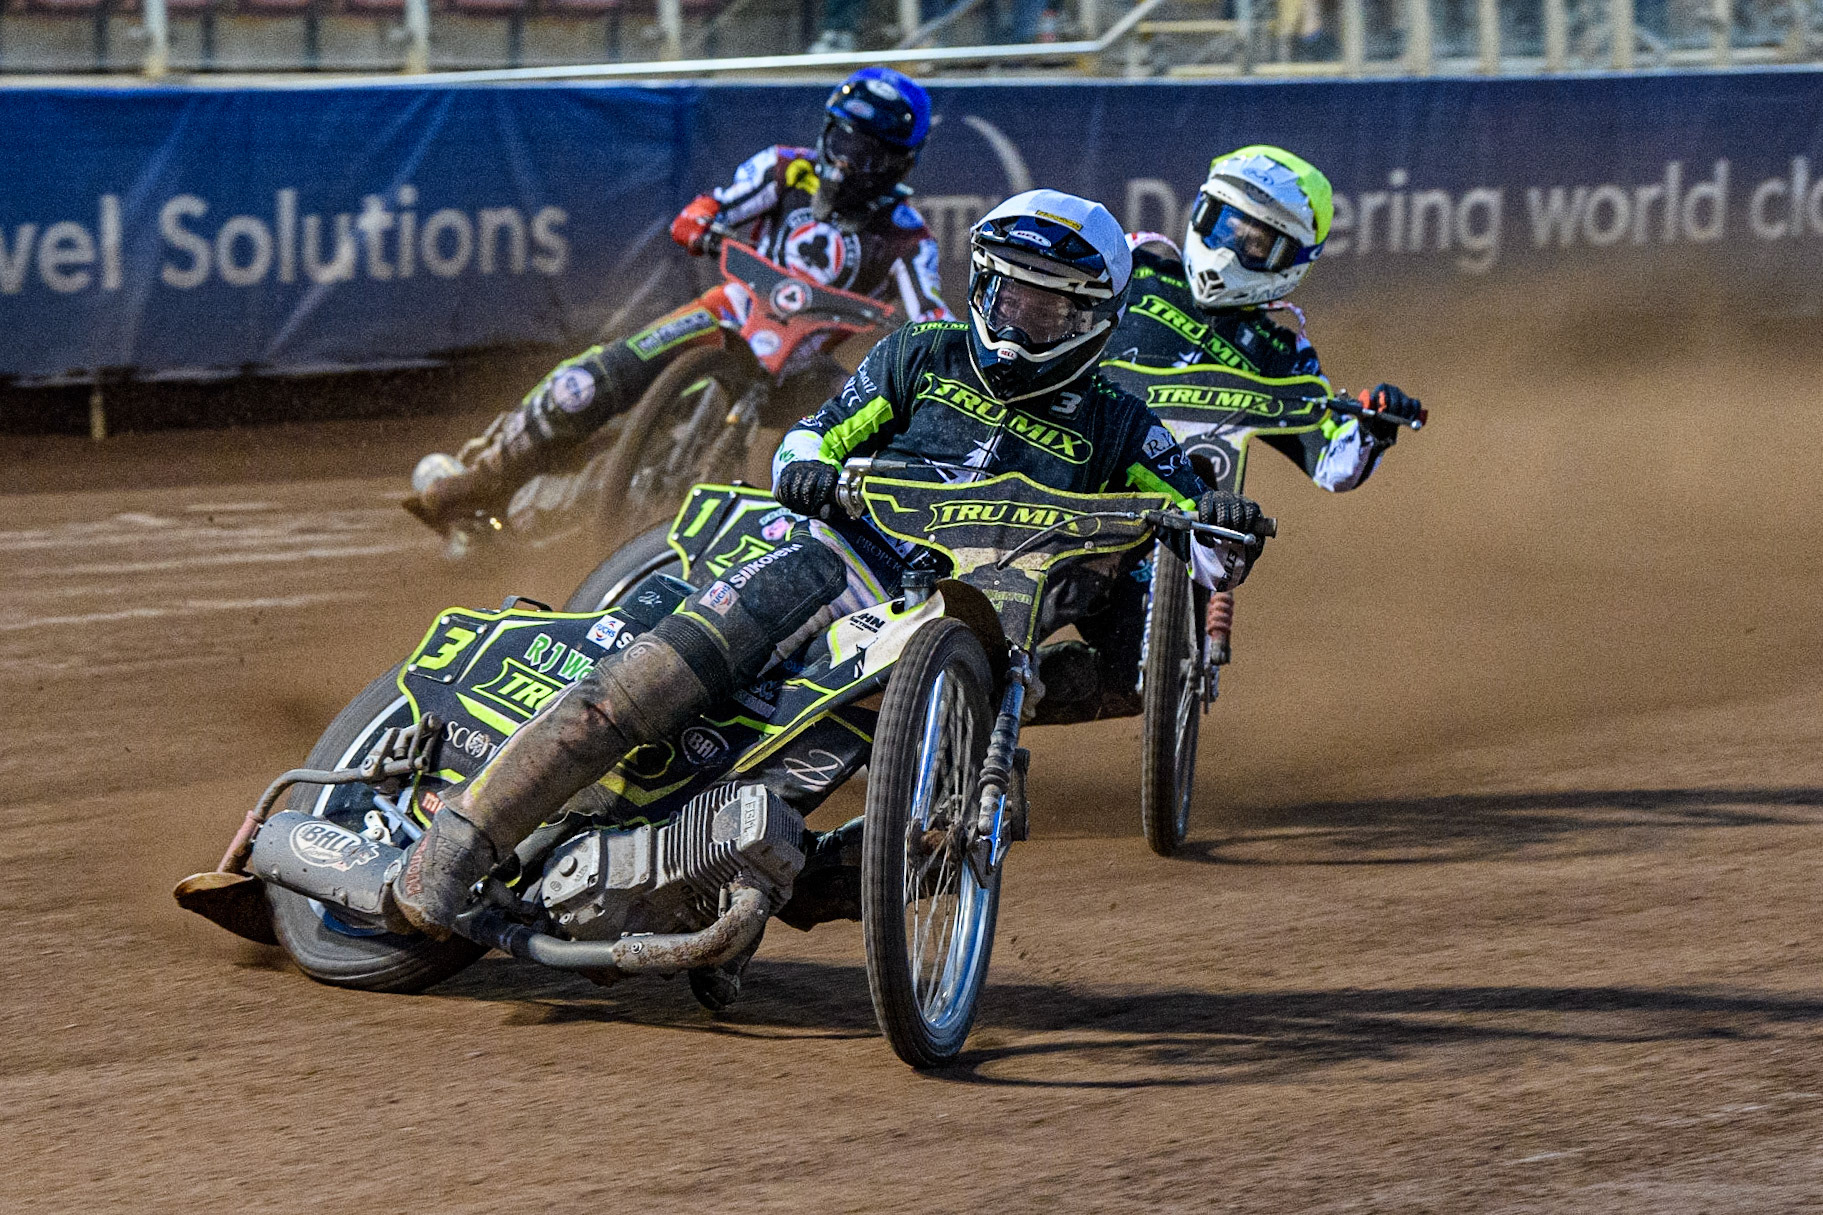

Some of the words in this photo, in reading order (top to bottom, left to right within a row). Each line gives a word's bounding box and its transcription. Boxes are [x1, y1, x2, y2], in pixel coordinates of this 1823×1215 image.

[1526, 157, 1731, 248] world
[159, 184, 568, 288] Solutions
[1148, 298, 1208, 341] TRU
[933, 382, 1008, 422] TRU
[1008, 413, 1083, 457] MIX
[1050, 390, 1083, 415] 3
[1158, 388, 1213, 405] TRU
[1215, 391, 1271, 413] MIX
[682, 498, 722, 538] 1
[940, 503, 1008, 523] TRU
[1010, 507, 1080, 534] MIX
[710, 584, 732, 608] FUCHS
[416, 626, 477, 671] 3
[594, 623, 616, 639] FUCHS
